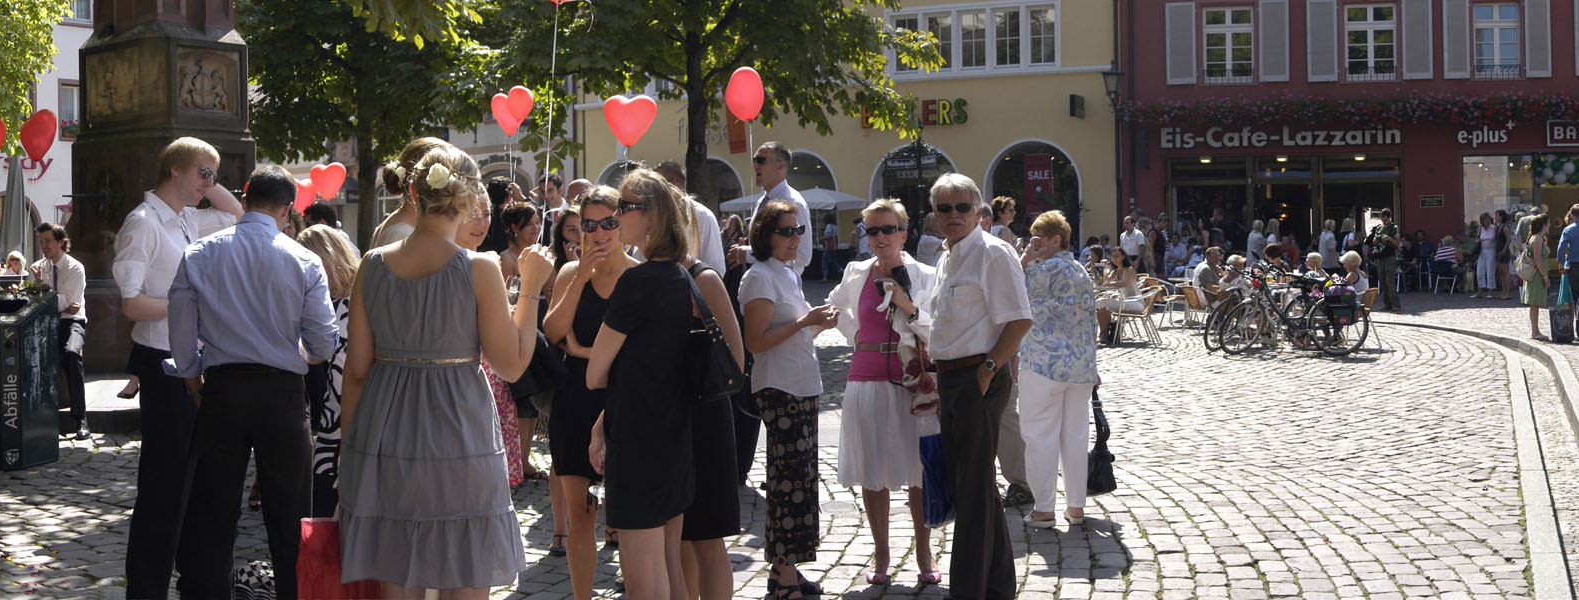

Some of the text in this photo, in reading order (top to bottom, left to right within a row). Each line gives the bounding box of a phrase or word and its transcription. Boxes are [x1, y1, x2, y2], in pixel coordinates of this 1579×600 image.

[1160, 125, 1402, 148] Eis-Cafe-Lazzarin
[1027, 170, 1050, 180] SALE
[3, 374, 18, 429] Abfälle
